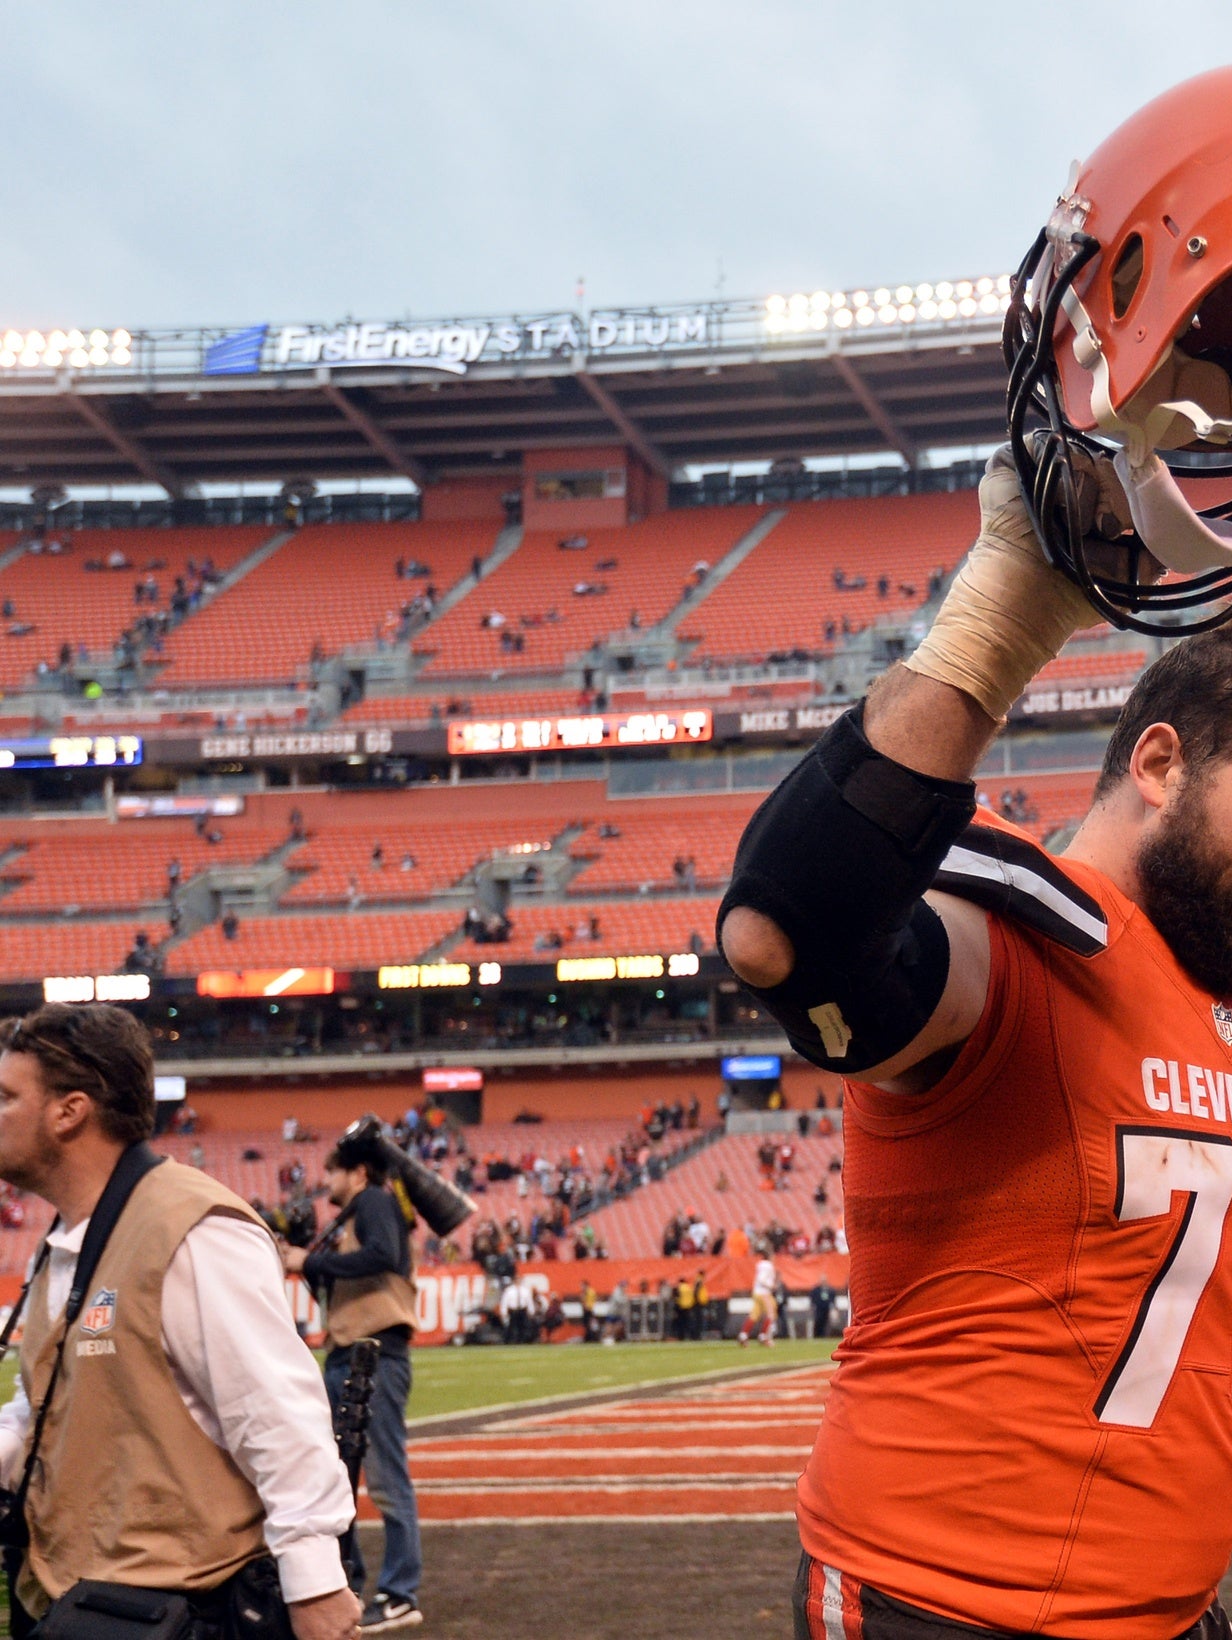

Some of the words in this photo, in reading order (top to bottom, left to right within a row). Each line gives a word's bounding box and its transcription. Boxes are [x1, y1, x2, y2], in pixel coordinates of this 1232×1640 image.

[275, 322, 490, 362] FirstEnergy
[499, 314, 707, 352] STADIUM
[740, 711, 788, 732] MIKE
[76, 1338, 117, 1357] MEDIA
